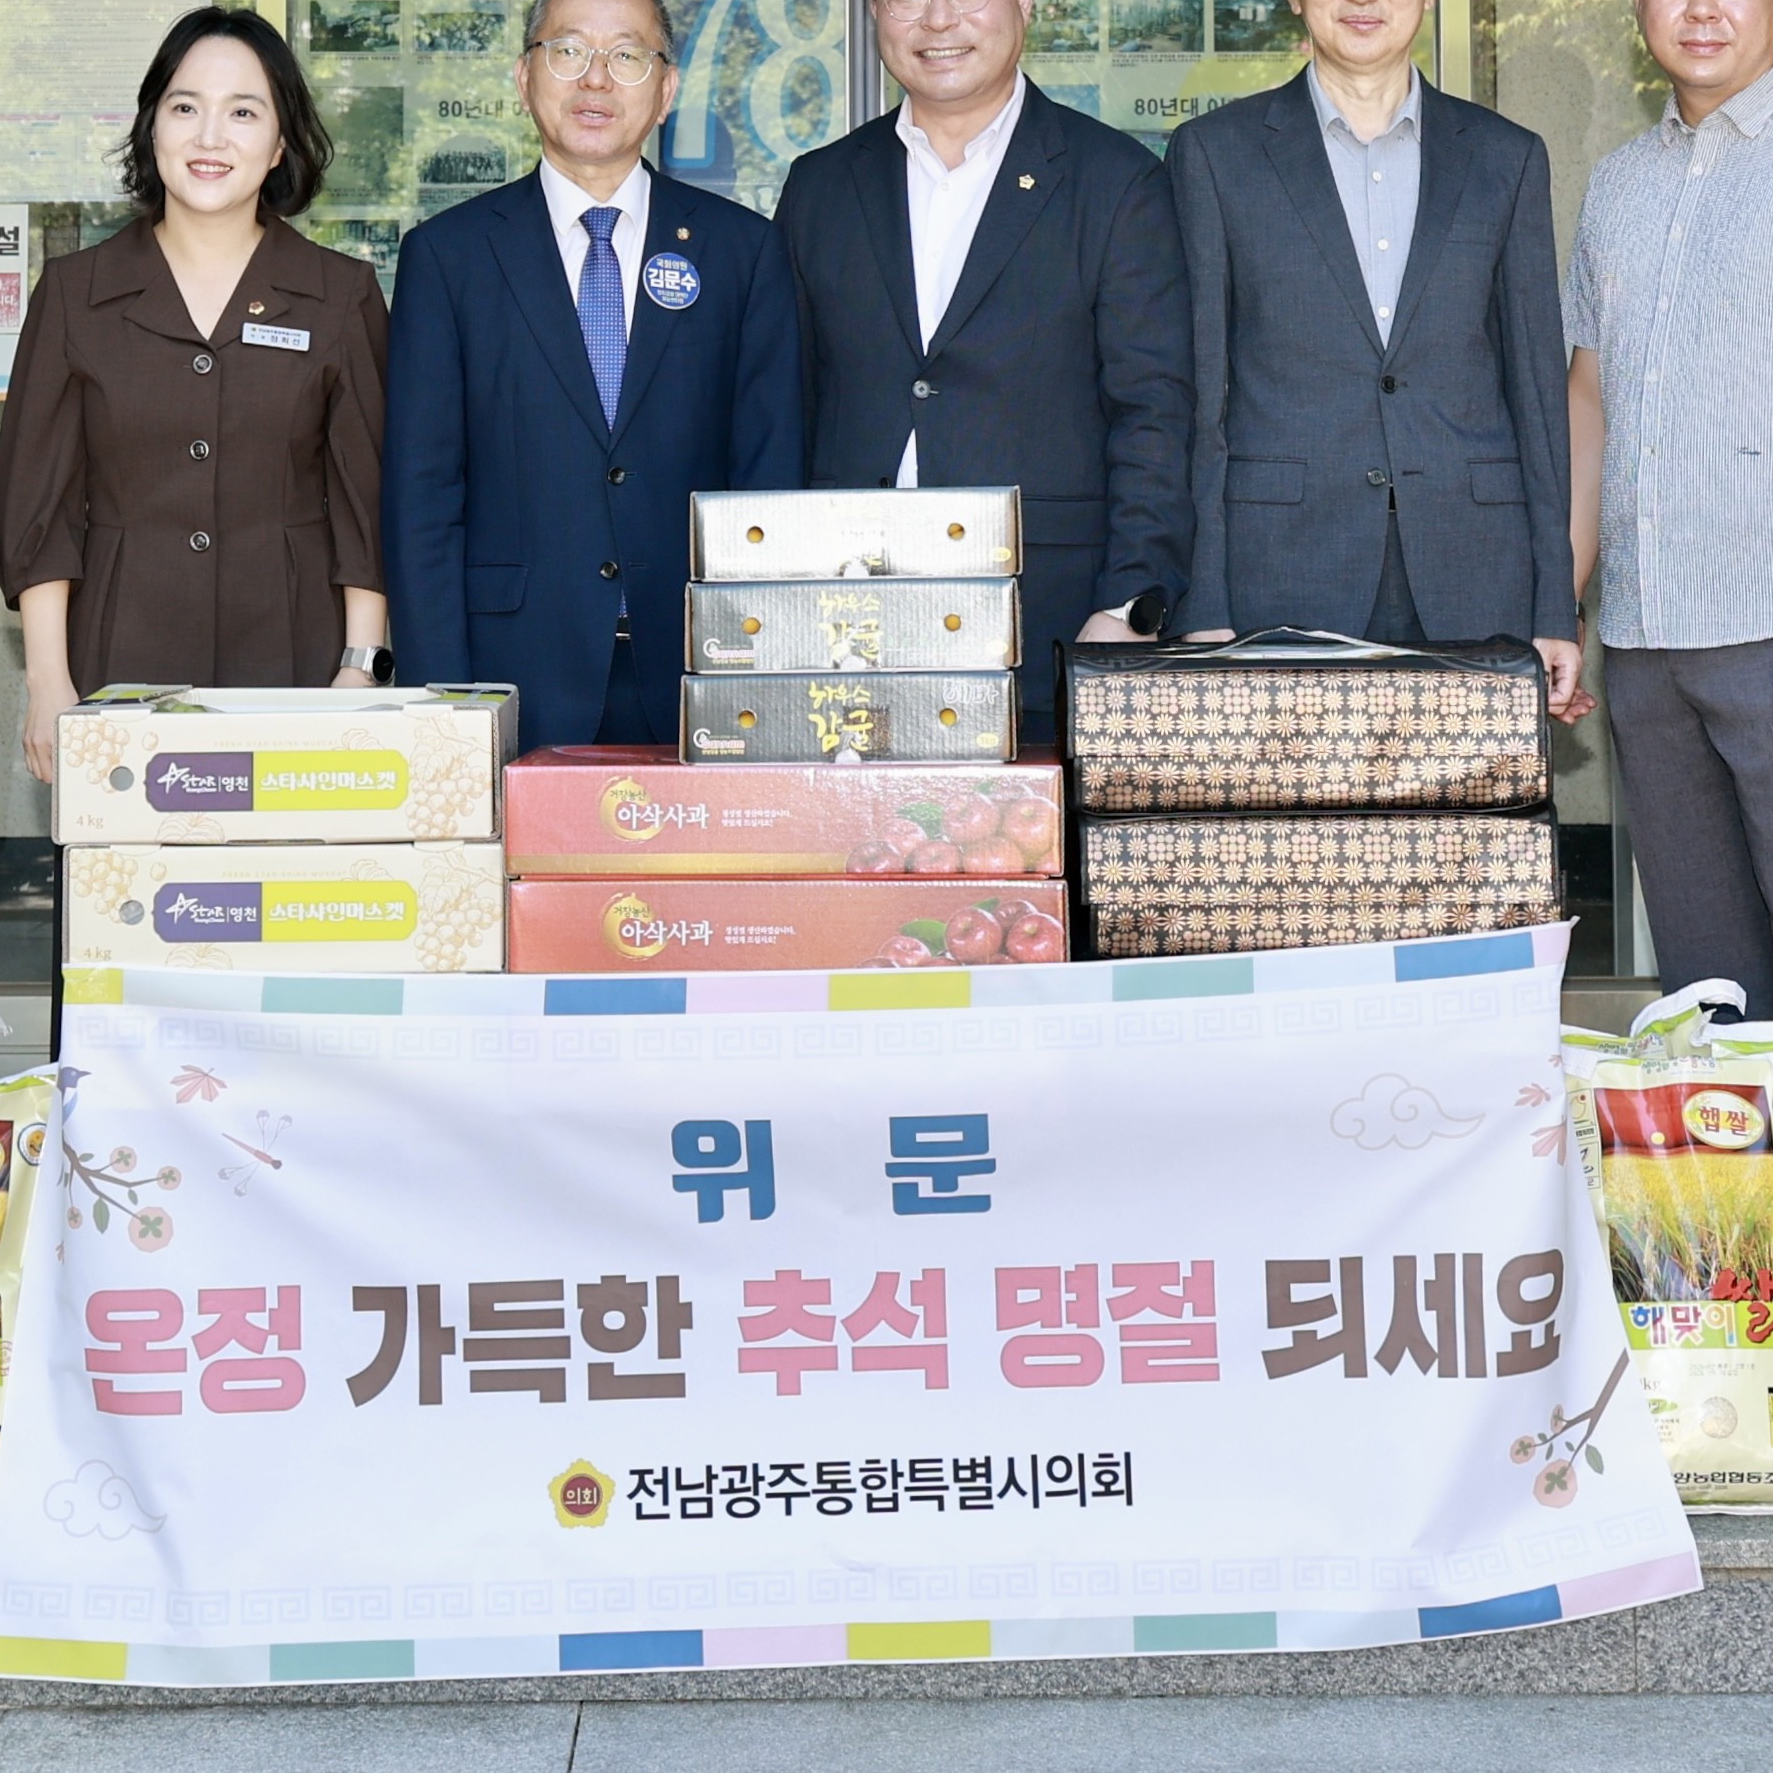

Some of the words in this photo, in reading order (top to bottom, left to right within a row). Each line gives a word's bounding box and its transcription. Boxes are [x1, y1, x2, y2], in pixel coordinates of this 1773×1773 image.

[438, 99, 505, 119] 80년대
[1134, 97, 1198, 118] 80년대
[648, 268, 697, 292] 김문수
[809, 709, 874, 753] 감귤
[221, 776, 249, 792] 영천
[618, 803, 710, 830] 아삭사과
[229, 906, 257, 923] 영천
[621, 919, 714, 947] 아삭사과
[1699, 1106, 1749, 1137] 햅쌀
[671, 1118, 777, 1224] 위
[885, 1113, 997, 1216] 문
[83, 1282, 307, 1416] 온정
[345, 1274, 693, 1409] 가득한
[737, 1268, 950, 1392] 추석
[994, 1259, 1221, 1391] 명절
[1261, 1247, 1565, 1381] 되세요
[1630, 1303, 1739, 1348] 해맞이
[626, 1450, 1136, 1520] 전남광주통합특별시의회
